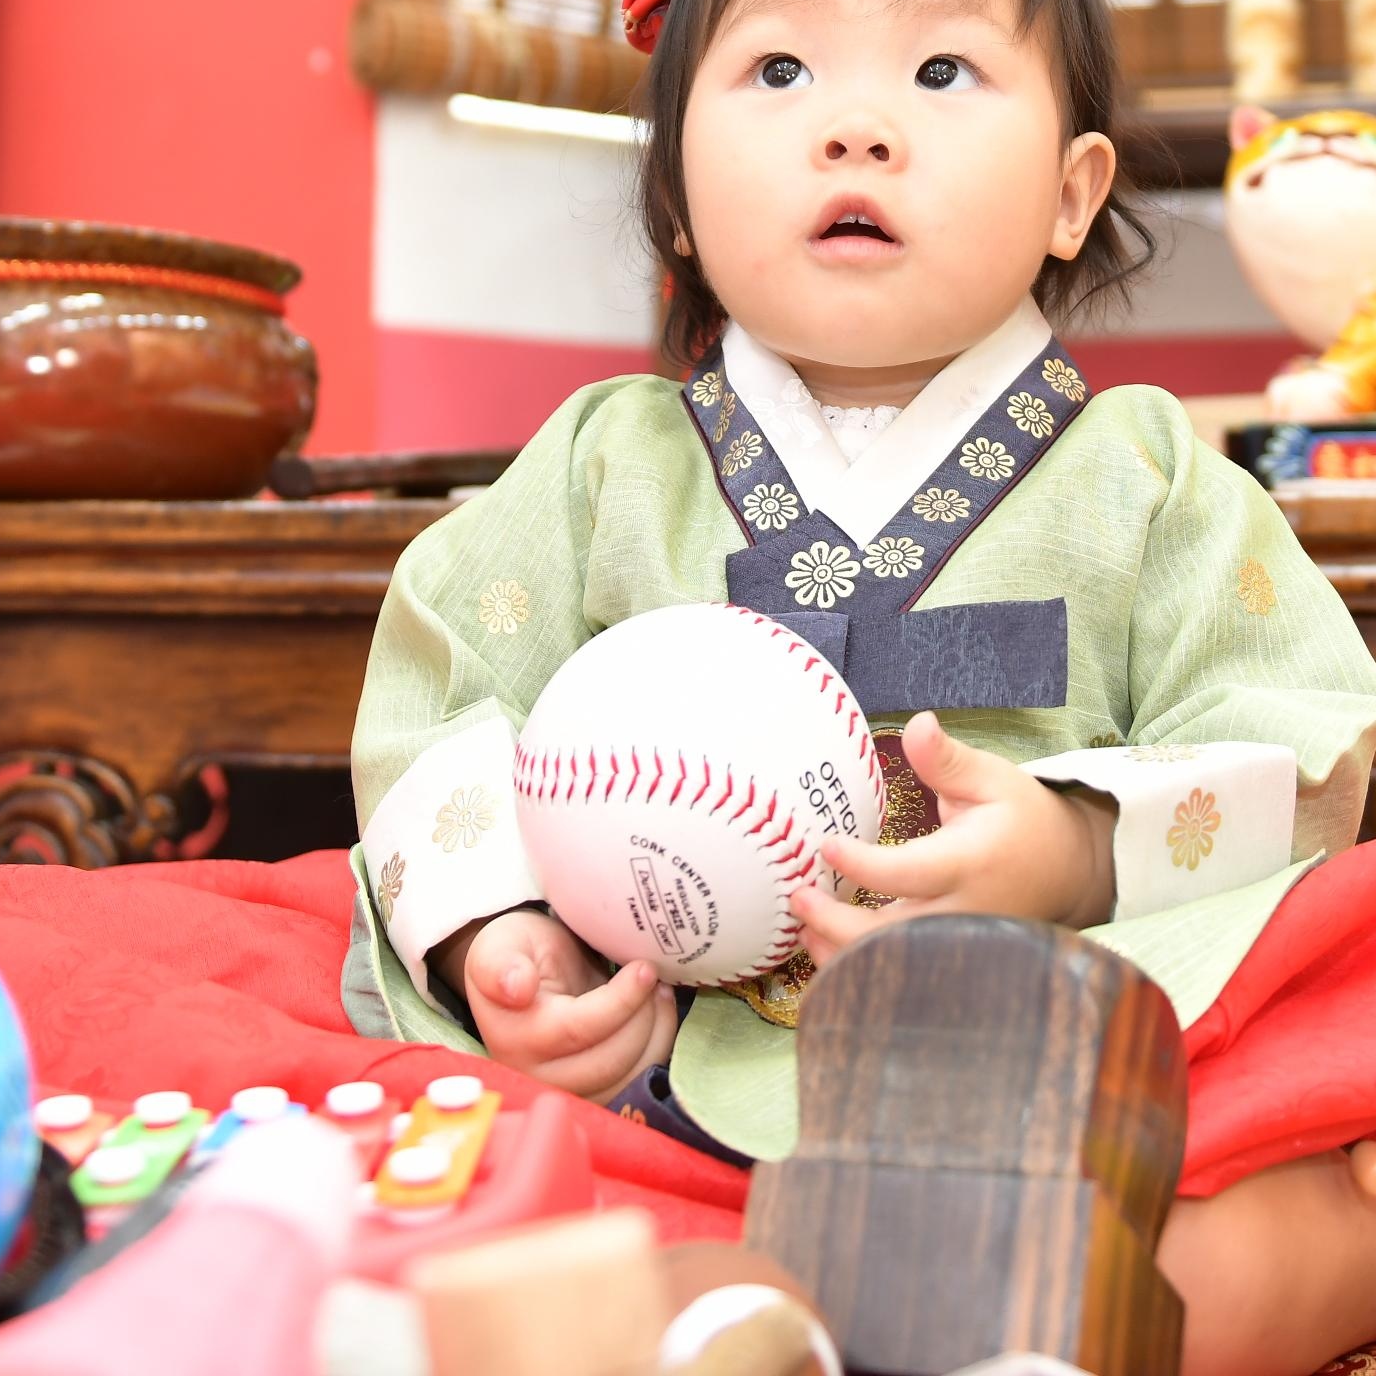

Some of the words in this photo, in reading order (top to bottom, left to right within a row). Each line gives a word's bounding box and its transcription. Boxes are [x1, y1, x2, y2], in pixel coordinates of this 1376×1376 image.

[820, 761, 860, 839] OFFICI
[629, 834, 666, 857] CORK
[671, 855, 712, 898] CENTER
[627, 896, 645, 932] TAIWAN
[675, 877, 701, 936] REGULATION
